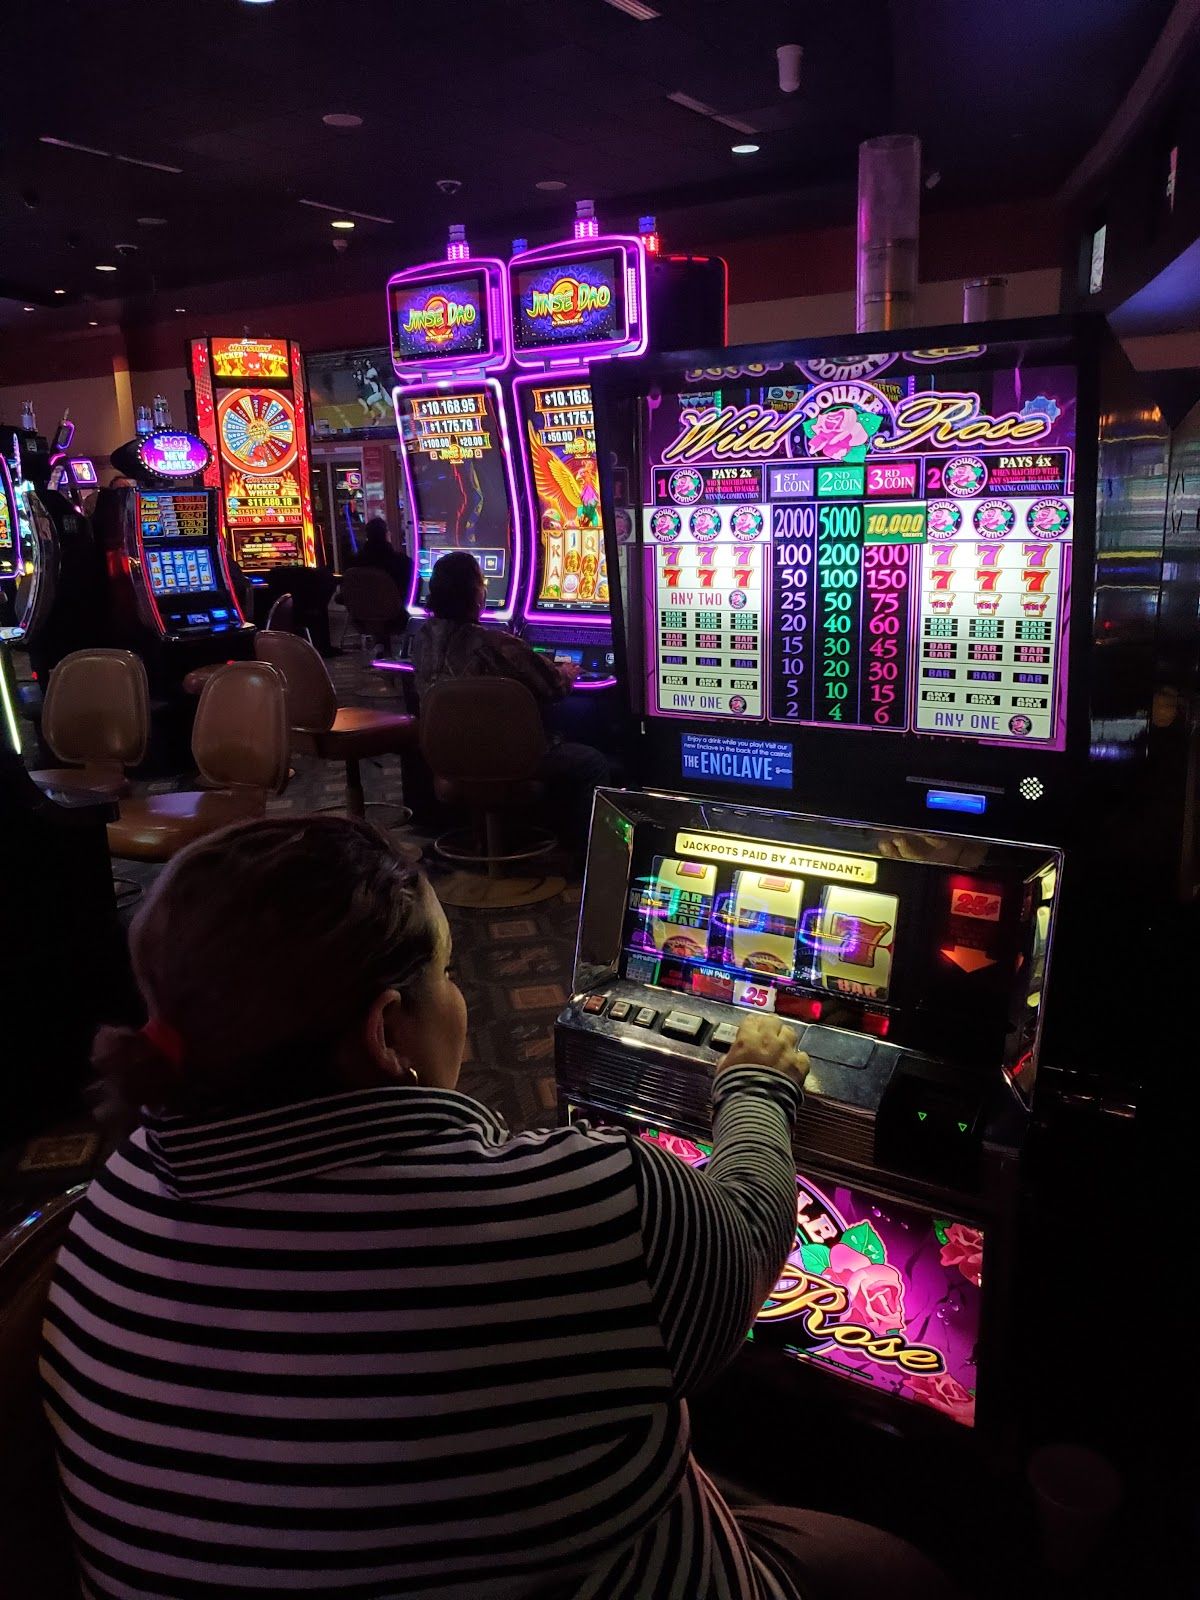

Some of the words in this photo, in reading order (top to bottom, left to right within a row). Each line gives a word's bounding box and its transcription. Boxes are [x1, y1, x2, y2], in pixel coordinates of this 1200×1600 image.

[526, 287, 574, 317] JINSE
[578, 283, 610, 308] DAO
[403, 309, 445, 332] JINSE
[447, 303, 476, 329] DAO
[802, 385, 884, 419] DOUBLE
[665, 406, 804, 460] Wild
[875, 394, 1050, 450] Rose
[950, 457, 982, 470] DOUBLE
[999, 456, 1033, 468] PAYS
[1036, 455, 1052, 467] 4x
[711, 469, 738, 479] PAYS
[739, 468, 752, 478] 2x
[834, 477, 862, 491] COIN
[884, 477, 914, 490] COIN
[927, 468, 941, 488] 2
[657, 478, 667, 497] 1
[784, 480, 811, 492] COIN
[774, 508, 814, 538] 2000
[818, 506, 860, 540] 5000
[867, 514, 923, 536] 10,000
[662, 546, 683, 566] 7
[695, 546, 717, 566] 7
[732, 545, 754, 567] 7
[777, 544, 811, 566] 100
[819, 544, 860, 566] 200
[865, 545, 909, 567] 300
[930, 544, 958, 567] 7
[975, 544, 1005, 567] 7
[1022, 544, 1053, 567] 7
[662, 568, 683, 587] 7
[696, 568, 718, 588] 7
[732, 568, 755, 588] 7
[781, 569, 807, 589] 50
[820, 570, 857, 588] 100
[866, 570, 906, 590] 150
[930, 570, 956, 591] 7
[974, 570, 1002, 592] 7
[1021, 570, 1051, 592] 7
[670, 592, 693, 605] ANY
[698, 592, 722, 606] TWO
[781, 592, 806, 611] 25
[824, 592, 851, 612] 50
[871, 593, 898, 613] 75
[781, 614, 806, 632] 20
[823, 613, 850, 633] 40
[869, 614, 899, 635] 60
[782, 636, 803, 654] 15
[823, 638, 850, 657] 30
[869, 638, 897, 658] 45
[782, 658, 803, 675] 10
[823, 660, 849, 677] 20
[869, 662, 897, 681] 30
[928, 669, 950, 677] BAR
[973, 671, 995, 680] BAR
[1019, 674, 1042, 683] BAR
[673, 694, 695, 707] ANY
[700, 696, 723, 710] ONE
[786, 680, 798, 697] 5
[825, 682, 847, 699] 10
[871, 684, 895, 703] 15
[786, 701, 798, 716] 2
[828, 703, 842, 721] 4
[874, 705, 889, 724] 6
[935, 712, 964, 727] ANY
[971, 715, 1000, 730] ONE
[696, 743, 718, 751] Enclave
[683, 755, 699, 768] THE
[701, 751, 773, 780] ENCLAVE
[682, 840, 739, 858] JACKPOTS
[741, 847, 768, 862] PAID
[770, 852, 787, 864] BY
[789, 856, 865, 877] ATTENDANT.
[744, 985, 768, 1007] 25
[755, 1264, 940, 1369] Rose
